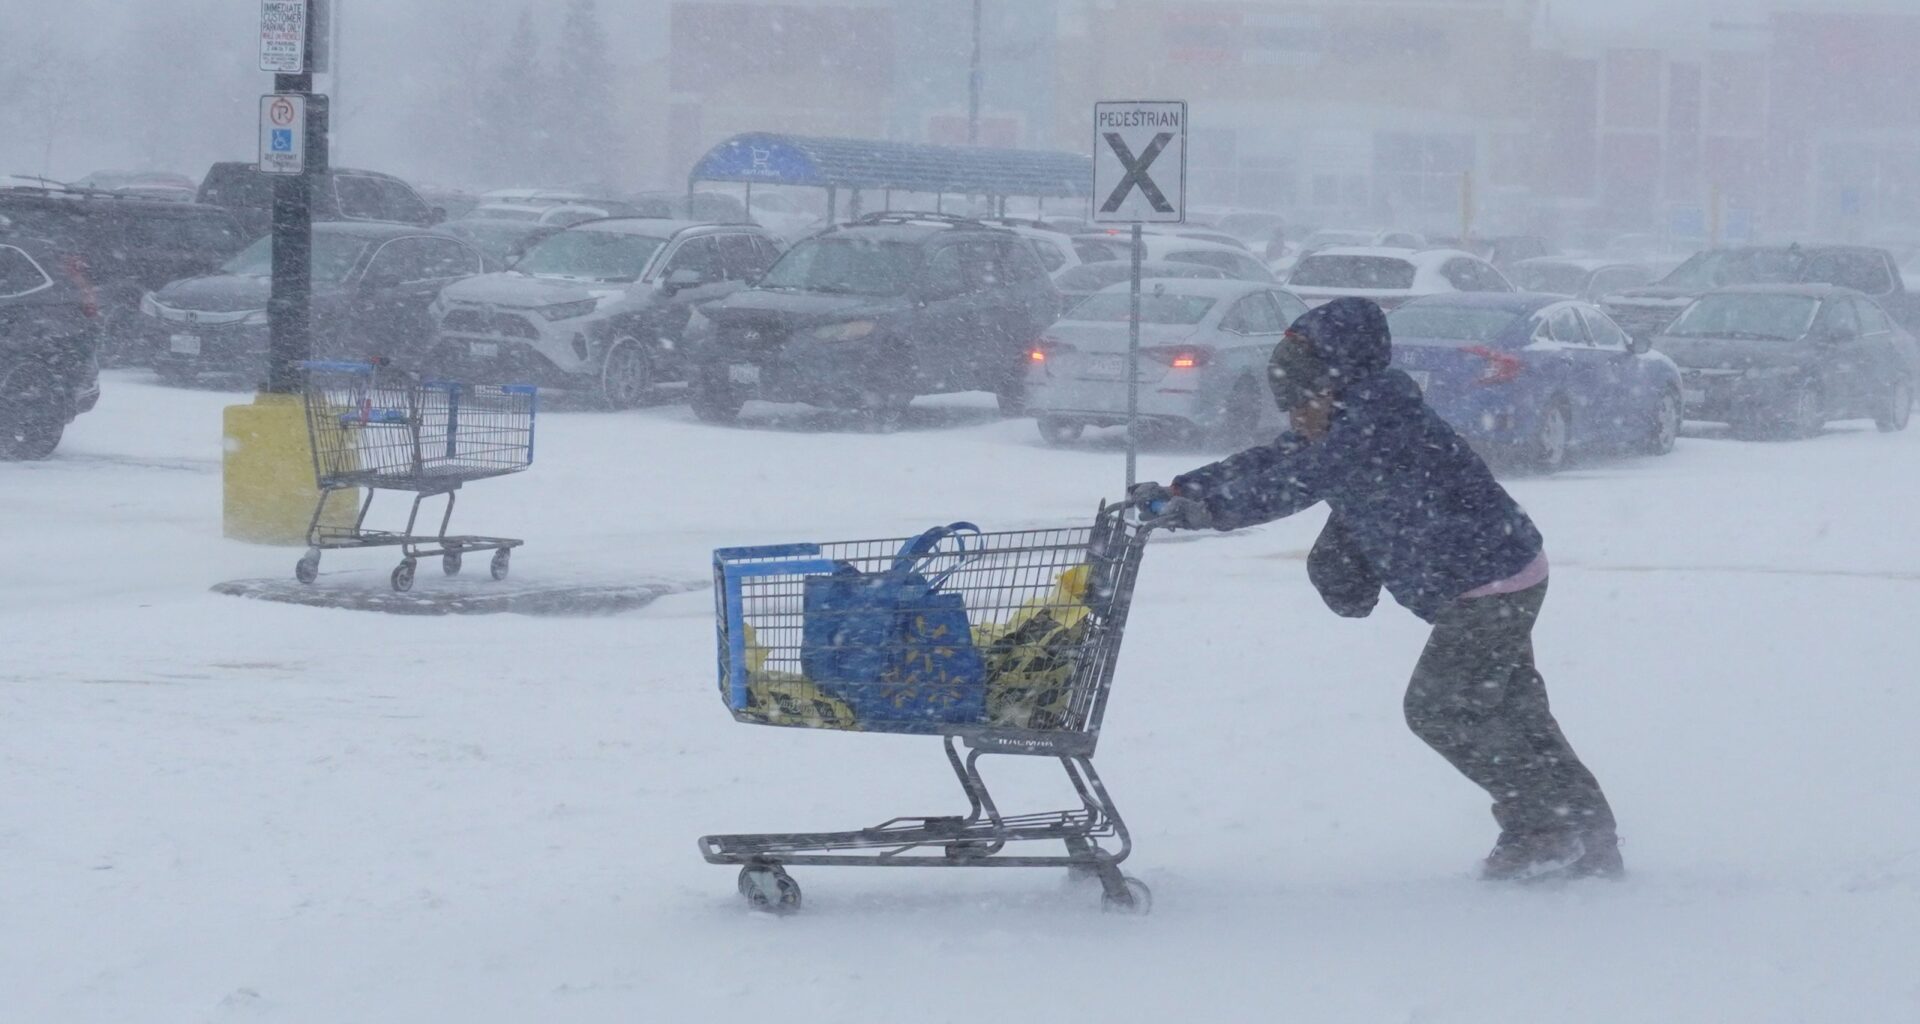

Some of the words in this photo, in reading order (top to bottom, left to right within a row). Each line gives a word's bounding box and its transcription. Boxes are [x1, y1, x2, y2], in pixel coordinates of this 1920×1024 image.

[263, 2, 302, 13] IMMEDIATE
[263, 12, 302, 23] CUSTOMER
[263, 22, 286, 32] PARKING
[287, 23, 301, 33] ONLY
[1099, 111, 1179, 127] PEDESTRIAN
